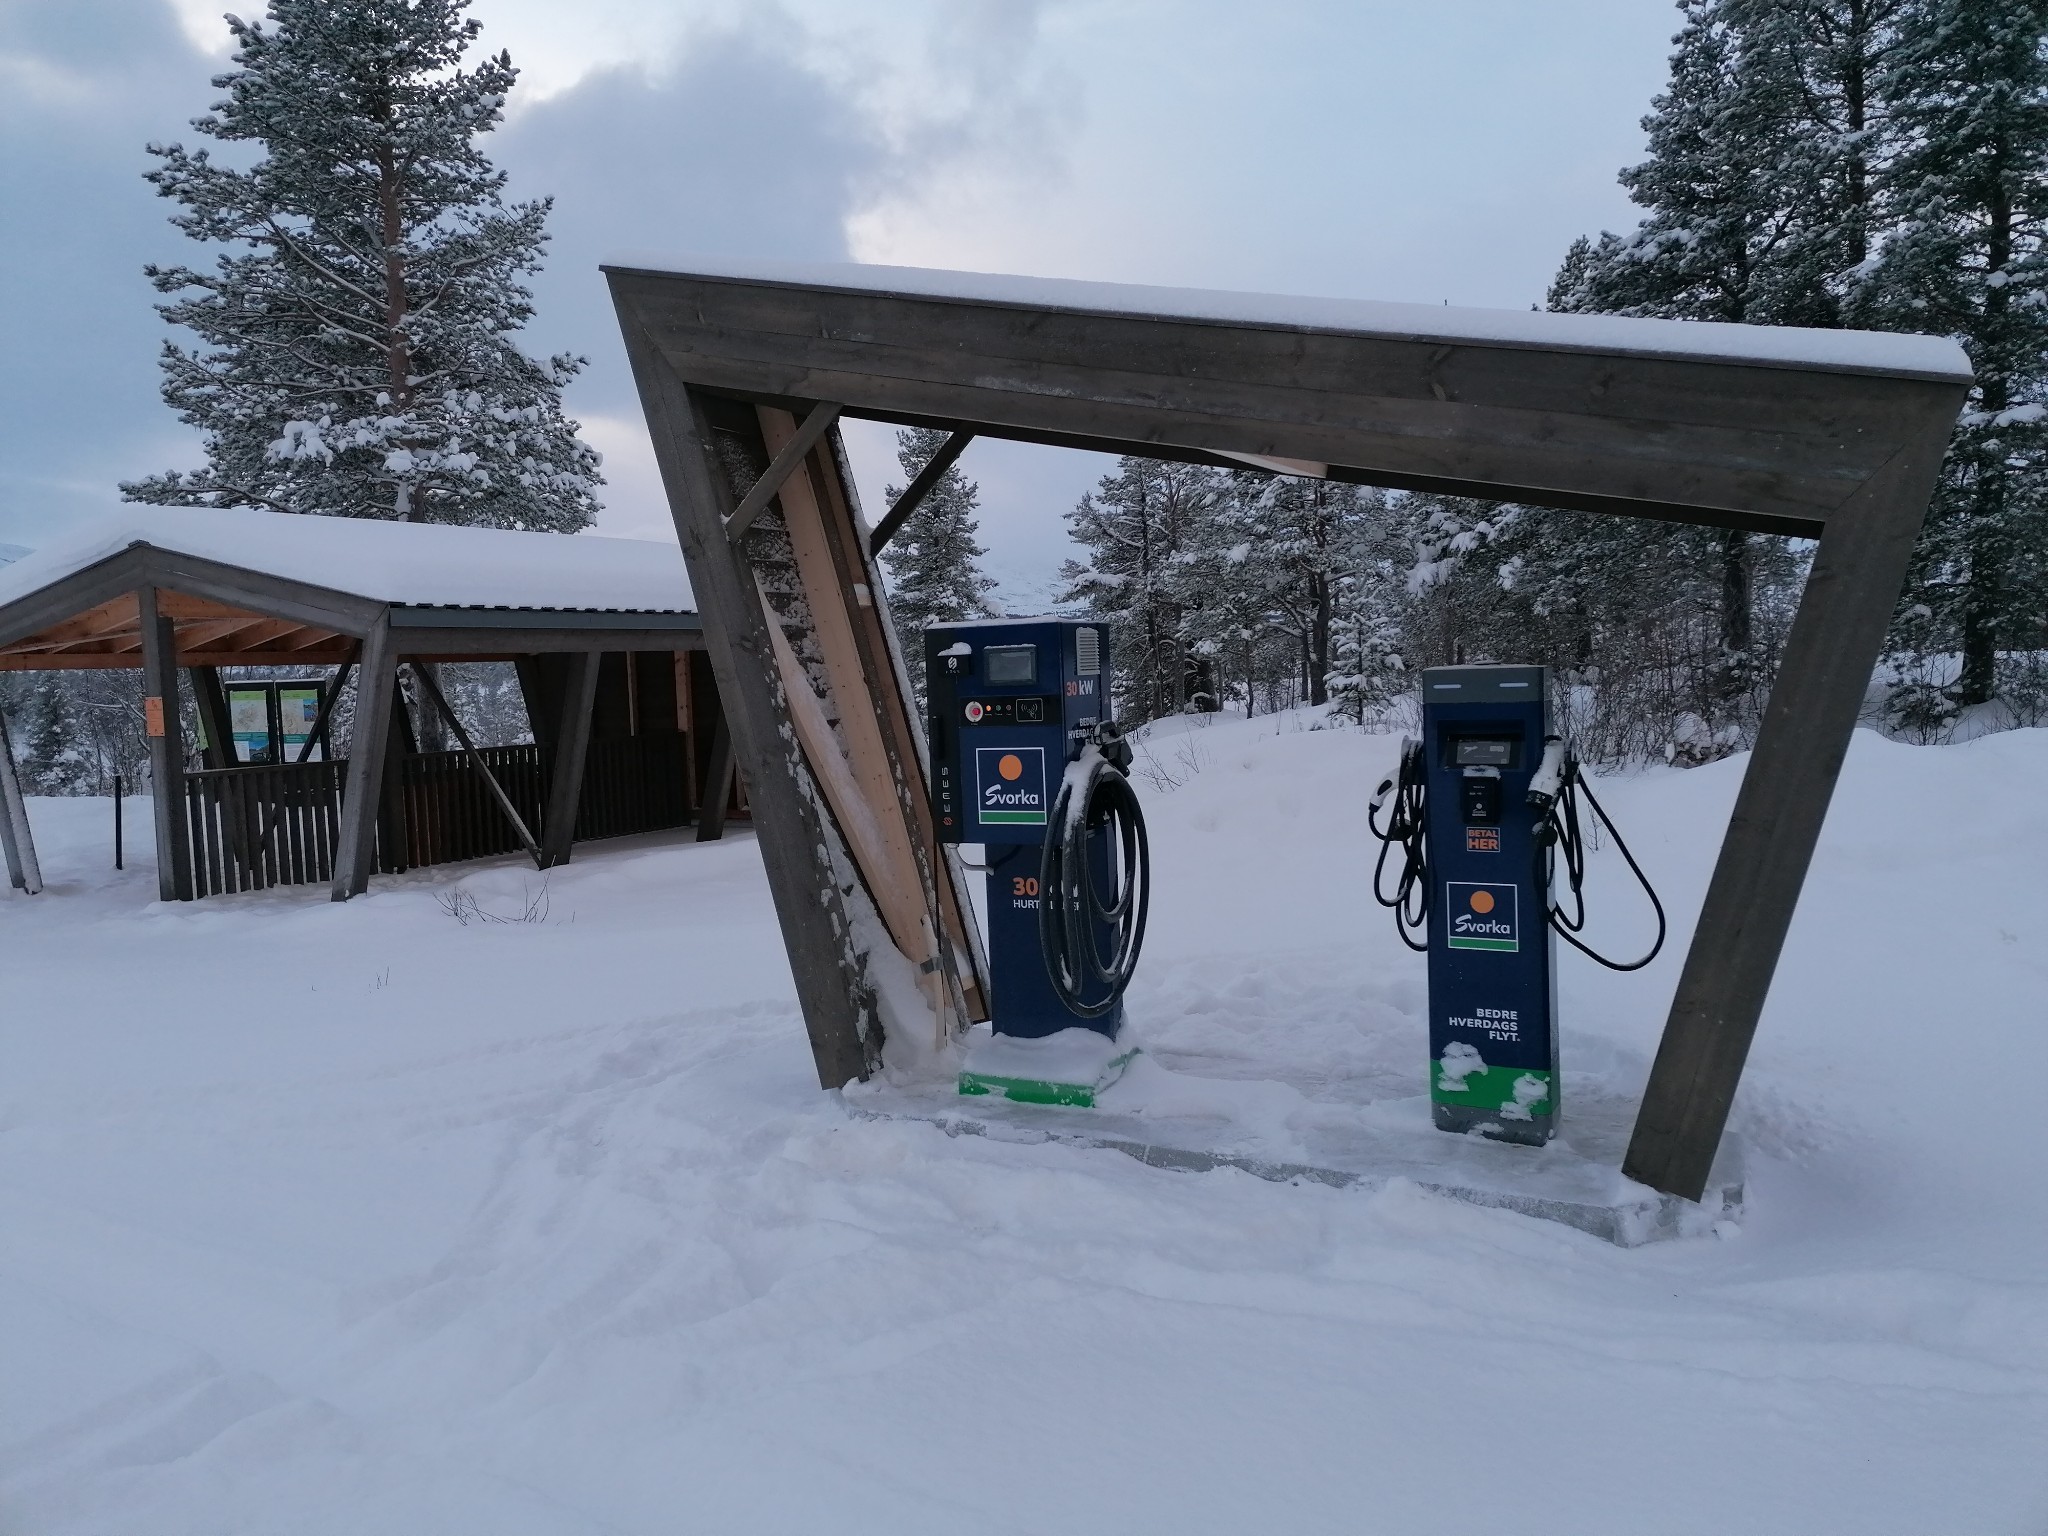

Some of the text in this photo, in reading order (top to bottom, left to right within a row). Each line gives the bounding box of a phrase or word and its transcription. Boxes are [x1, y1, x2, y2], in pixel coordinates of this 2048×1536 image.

[1066, 680, 1093, 696] 30 kW
[1080, 717, 1096, 726] BEDRE
[1067, 728, 1094, 739] HVERDAG
[985, 784, 1039, 805] Svorka
[1468, 839, 1498, 849] HER
[1013, 877, 1038, 896] 30
[1455, 914, 1510, 934] Svorka
[1476, 1008, 1518, 1020] BEDRE
[1449, 1017, 1518, 1031] HVERDAGS
[1489, 1031, 1520, 1041] FLYT.
